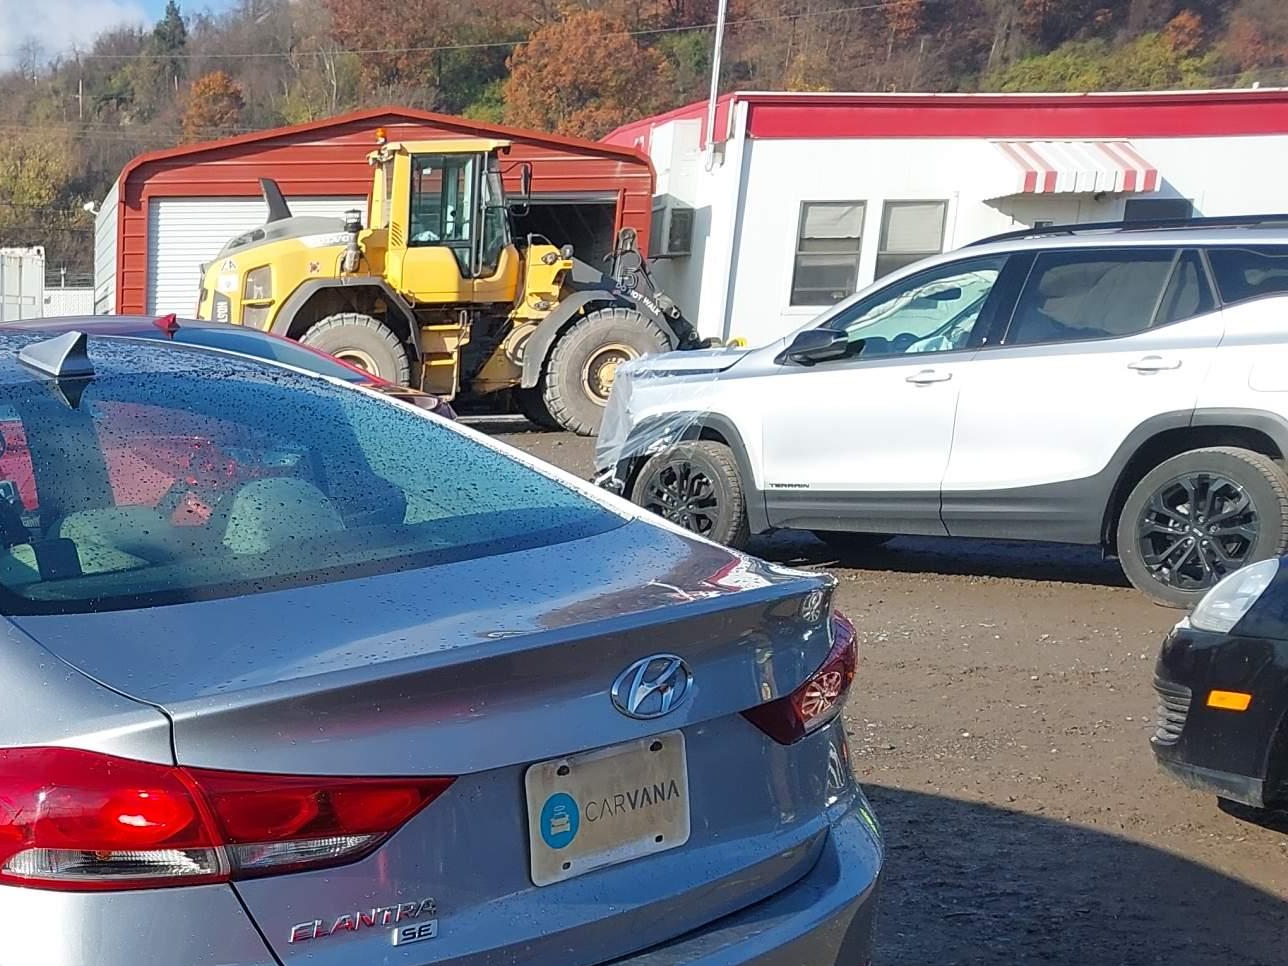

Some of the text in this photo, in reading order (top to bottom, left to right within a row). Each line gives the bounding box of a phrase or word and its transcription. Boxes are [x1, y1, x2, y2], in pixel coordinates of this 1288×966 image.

[643, 298, 661, 316] WALK
[585, 779, 680, 822] CARVANA
[288, 897, 437, 944] ELANTRA
[401, 923, 433, 942] SE
